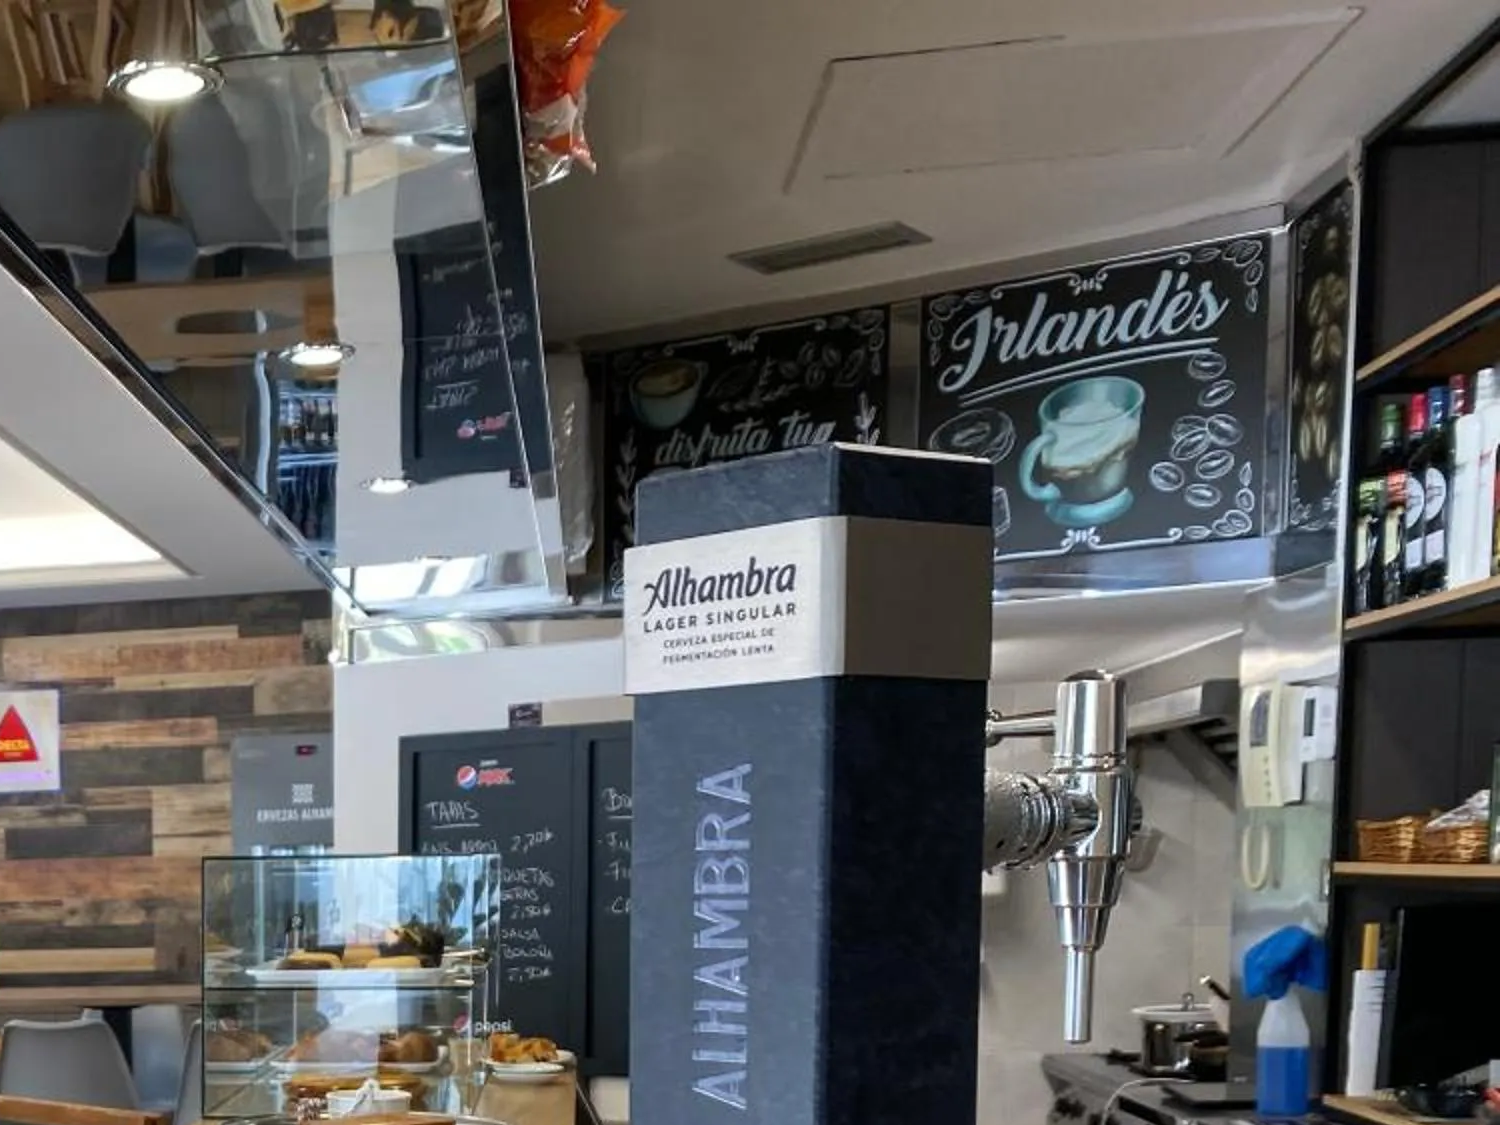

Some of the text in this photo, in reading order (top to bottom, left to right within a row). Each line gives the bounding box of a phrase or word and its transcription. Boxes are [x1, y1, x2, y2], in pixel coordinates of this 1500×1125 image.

[938, 270, 1230, 393] Irlandés
[655, 418, 773, 467] disfruta
[643, 556, 797, 616] Alhambra
[643, 602, 797, 633] LAGER SINGULAR
[663, 627, 775, 649] CERVEZA ESPECIAL DE
[741, 644, 774, 656] LENTA
[691, 761, 754, 1110] ALHAMBRA
[475, 1019, 513, 1034] pepsi
